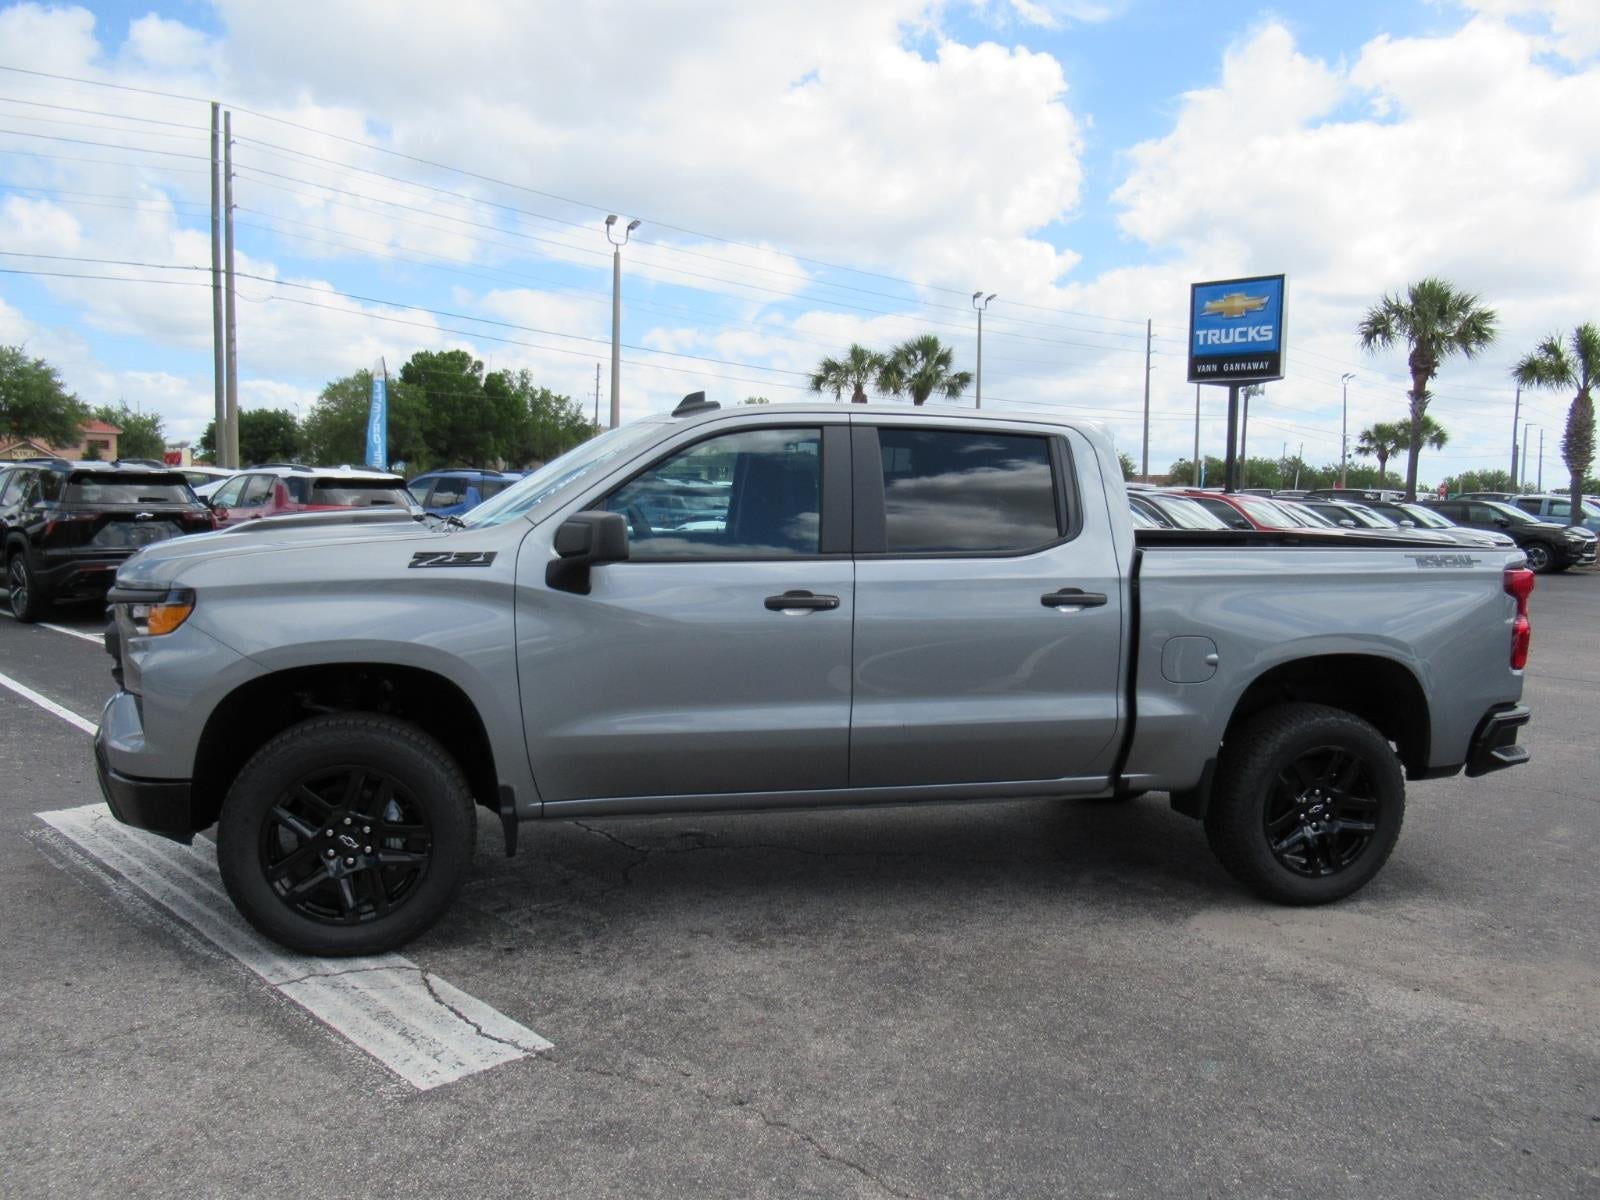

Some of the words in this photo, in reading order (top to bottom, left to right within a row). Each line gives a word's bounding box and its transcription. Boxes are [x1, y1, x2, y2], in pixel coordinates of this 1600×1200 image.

[1196, 325, 1273, 345] TRUCKS
[1197, 364, 1217, 373] VANN
[1223, 361, 1269, 372] GANNAWAY
